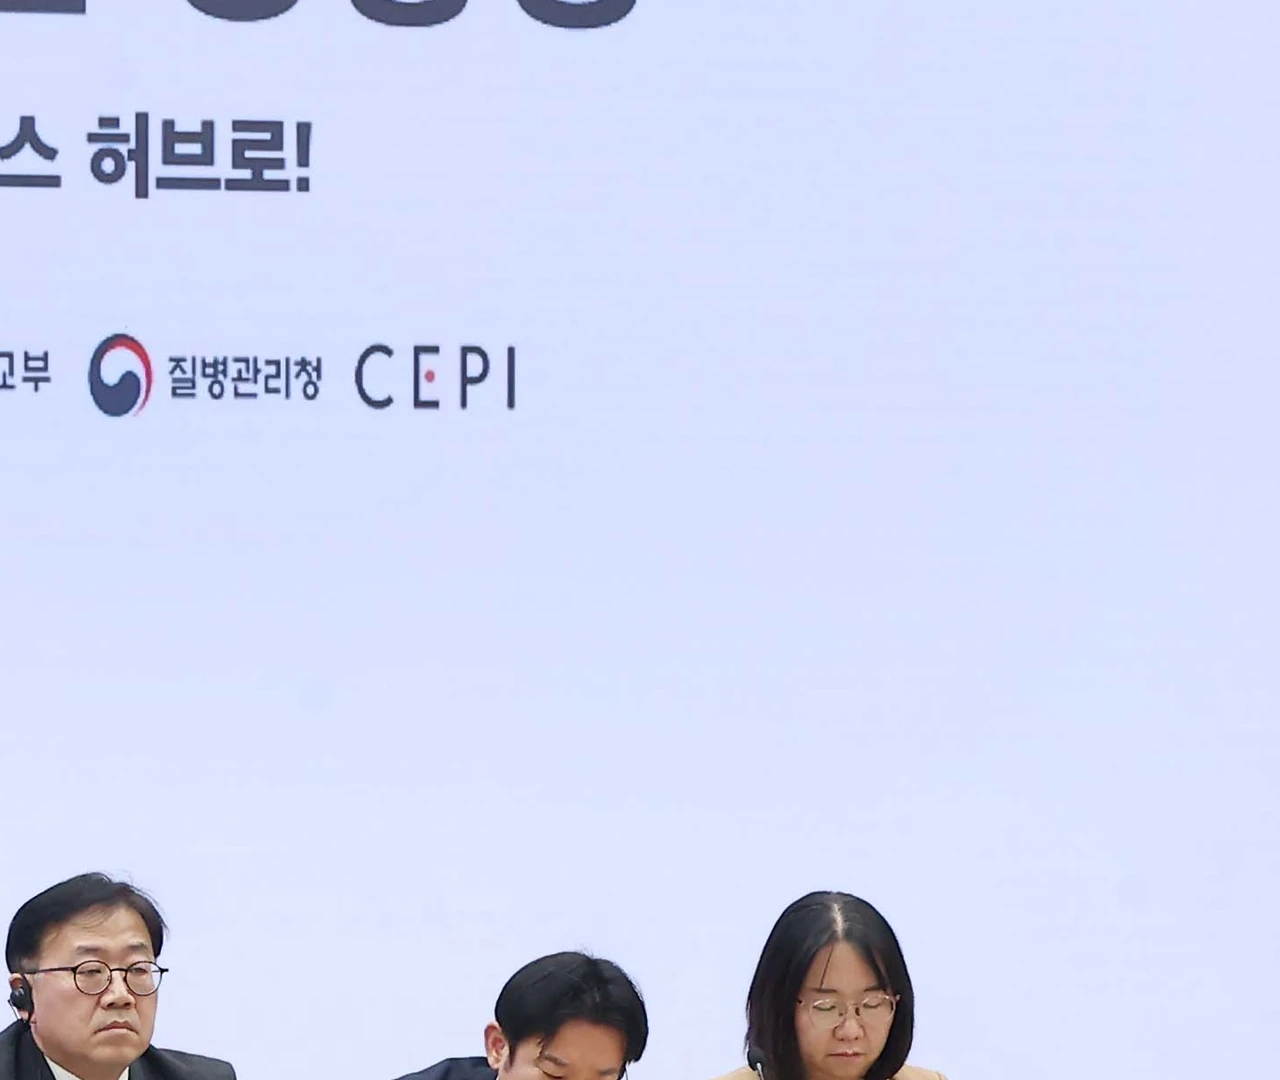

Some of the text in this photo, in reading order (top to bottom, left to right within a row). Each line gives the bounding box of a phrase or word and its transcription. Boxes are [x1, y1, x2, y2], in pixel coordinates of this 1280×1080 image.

[86, 112, 312, 199] 허브로!
[168, 356, 322, 400] 질병관리청
[355, 343, 515, 410] CEPI
